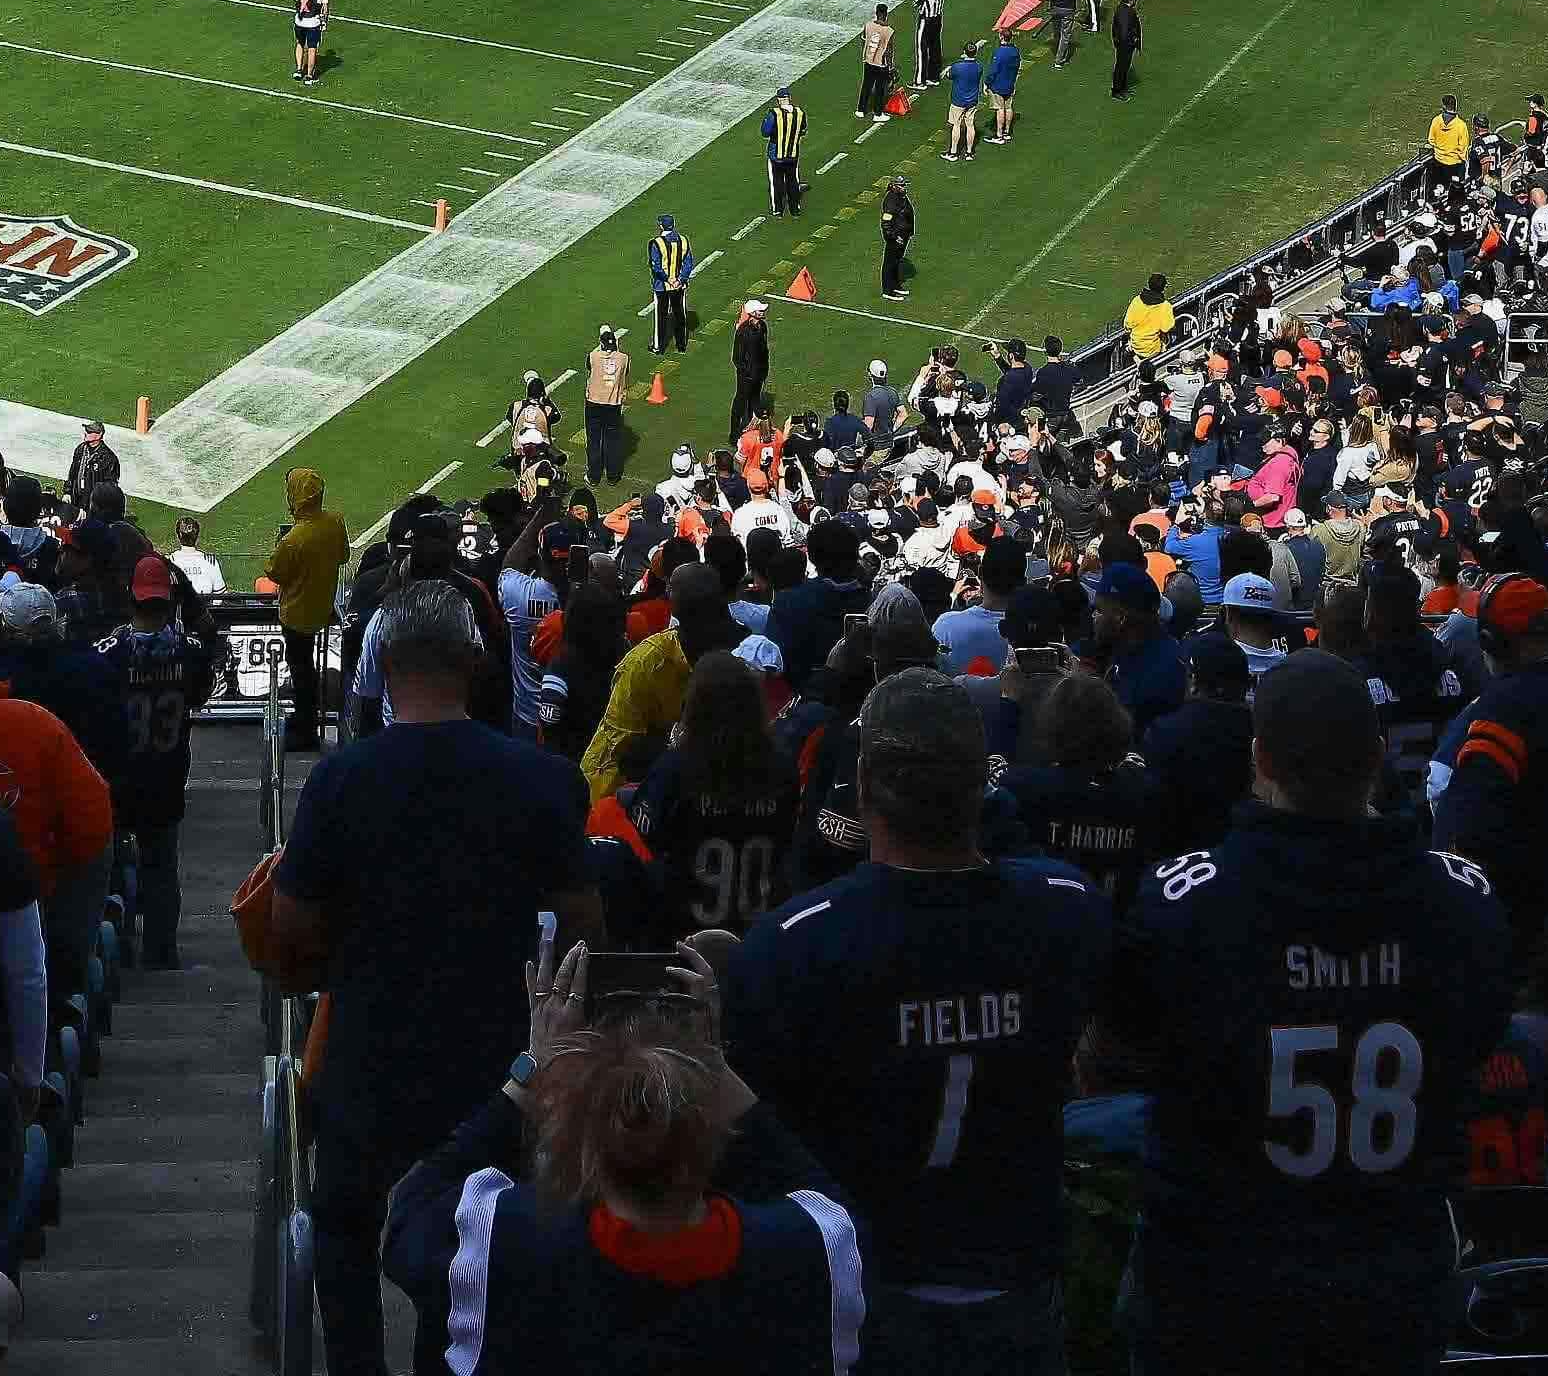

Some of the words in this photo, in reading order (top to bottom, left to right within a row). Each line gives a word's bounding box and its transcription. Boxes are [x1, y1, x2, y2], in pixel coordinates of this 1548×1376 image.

[1505, 216, 1528, 244] 73
[1469, 477, 1494, 508] 22
[247, 639, 284, 664] 89
[1071, 822, 1136, 850] HARRIS
[692, 839, 775, 927] 90
[1286, 942, 1402, 990] SMITH
[899, 991, 1021, 1046] FIELDS
[928, 1054, 975, 1168] 1
[1264, 1023, 1425, 1178] 58
